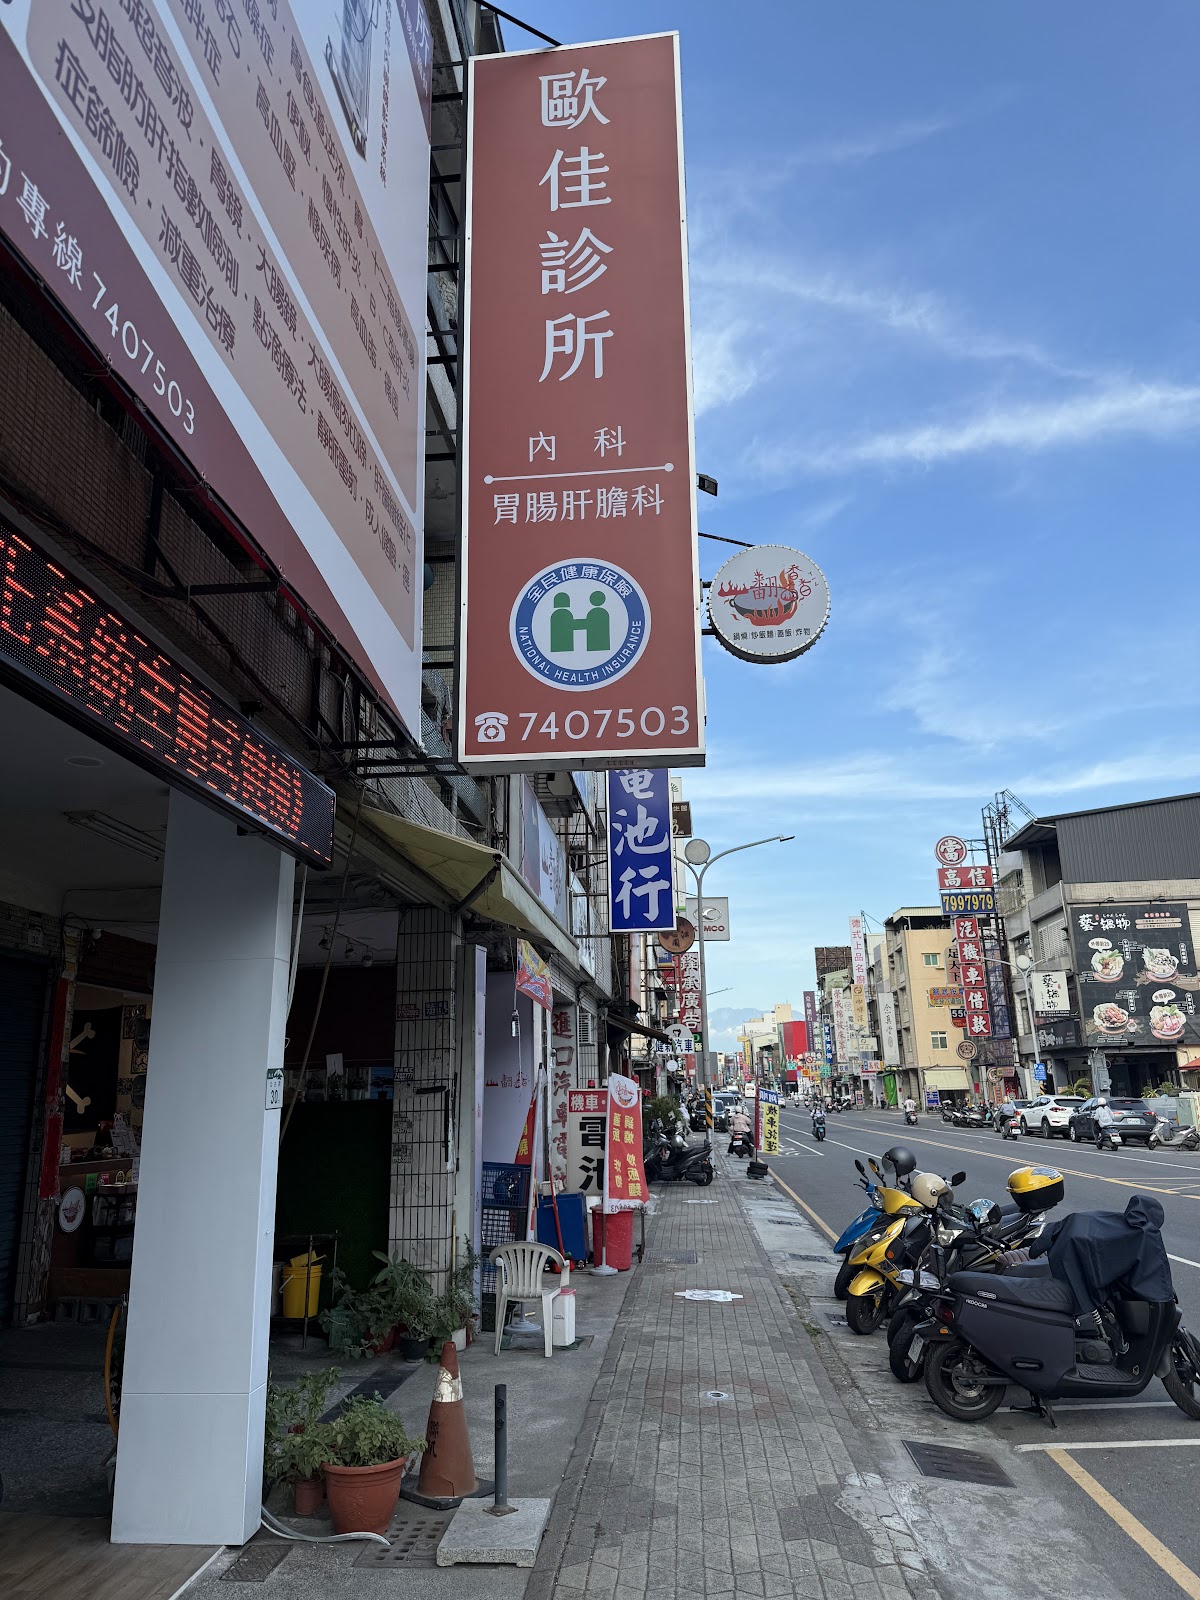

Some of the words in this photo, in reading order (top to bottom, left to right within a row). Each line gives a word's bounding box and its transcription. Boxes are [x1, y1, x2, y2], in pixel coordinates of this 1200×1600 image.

[55, 38, 140, 206] 症篩檢
[158, 204, 237, 361] 減重治療
[210, 144, 243, 240] 胃鏡
[256, 244, 297, 342] 大腸鏡
[256, 75, 296, 192] 高血壓
[308, 196, 341, 289] 糖尿病
[351, 292, 377, 369] 高血脂
[322, 174, 361, 287] 慢性肝炎
[538, 68, 614, 383] 歐佳診所
[92, 271, 195, 436] 7407503
[253, 296, 307, 414] 點滴療法
[318, 409, 357, 502] 靜脈雷射
[365, 497, 396, 572] 成人健檢
[493, 483, 665, 525] 胃腸肝膽科
[526, 565, 634, 603] 全民健康保險
[519, 626, 551, 675] NATIONAL
[554, 669, 600, 684] HEALTH
[602, 620, 642, 676] INSURANCE
[518, 706, 690, 741] 7407503
[612, 769, 671, 922] 電池行
[940, 840, 962, 861] 當
[944, 867, 986, 887] 高信
[942, 894, 994, 912] 7997979
